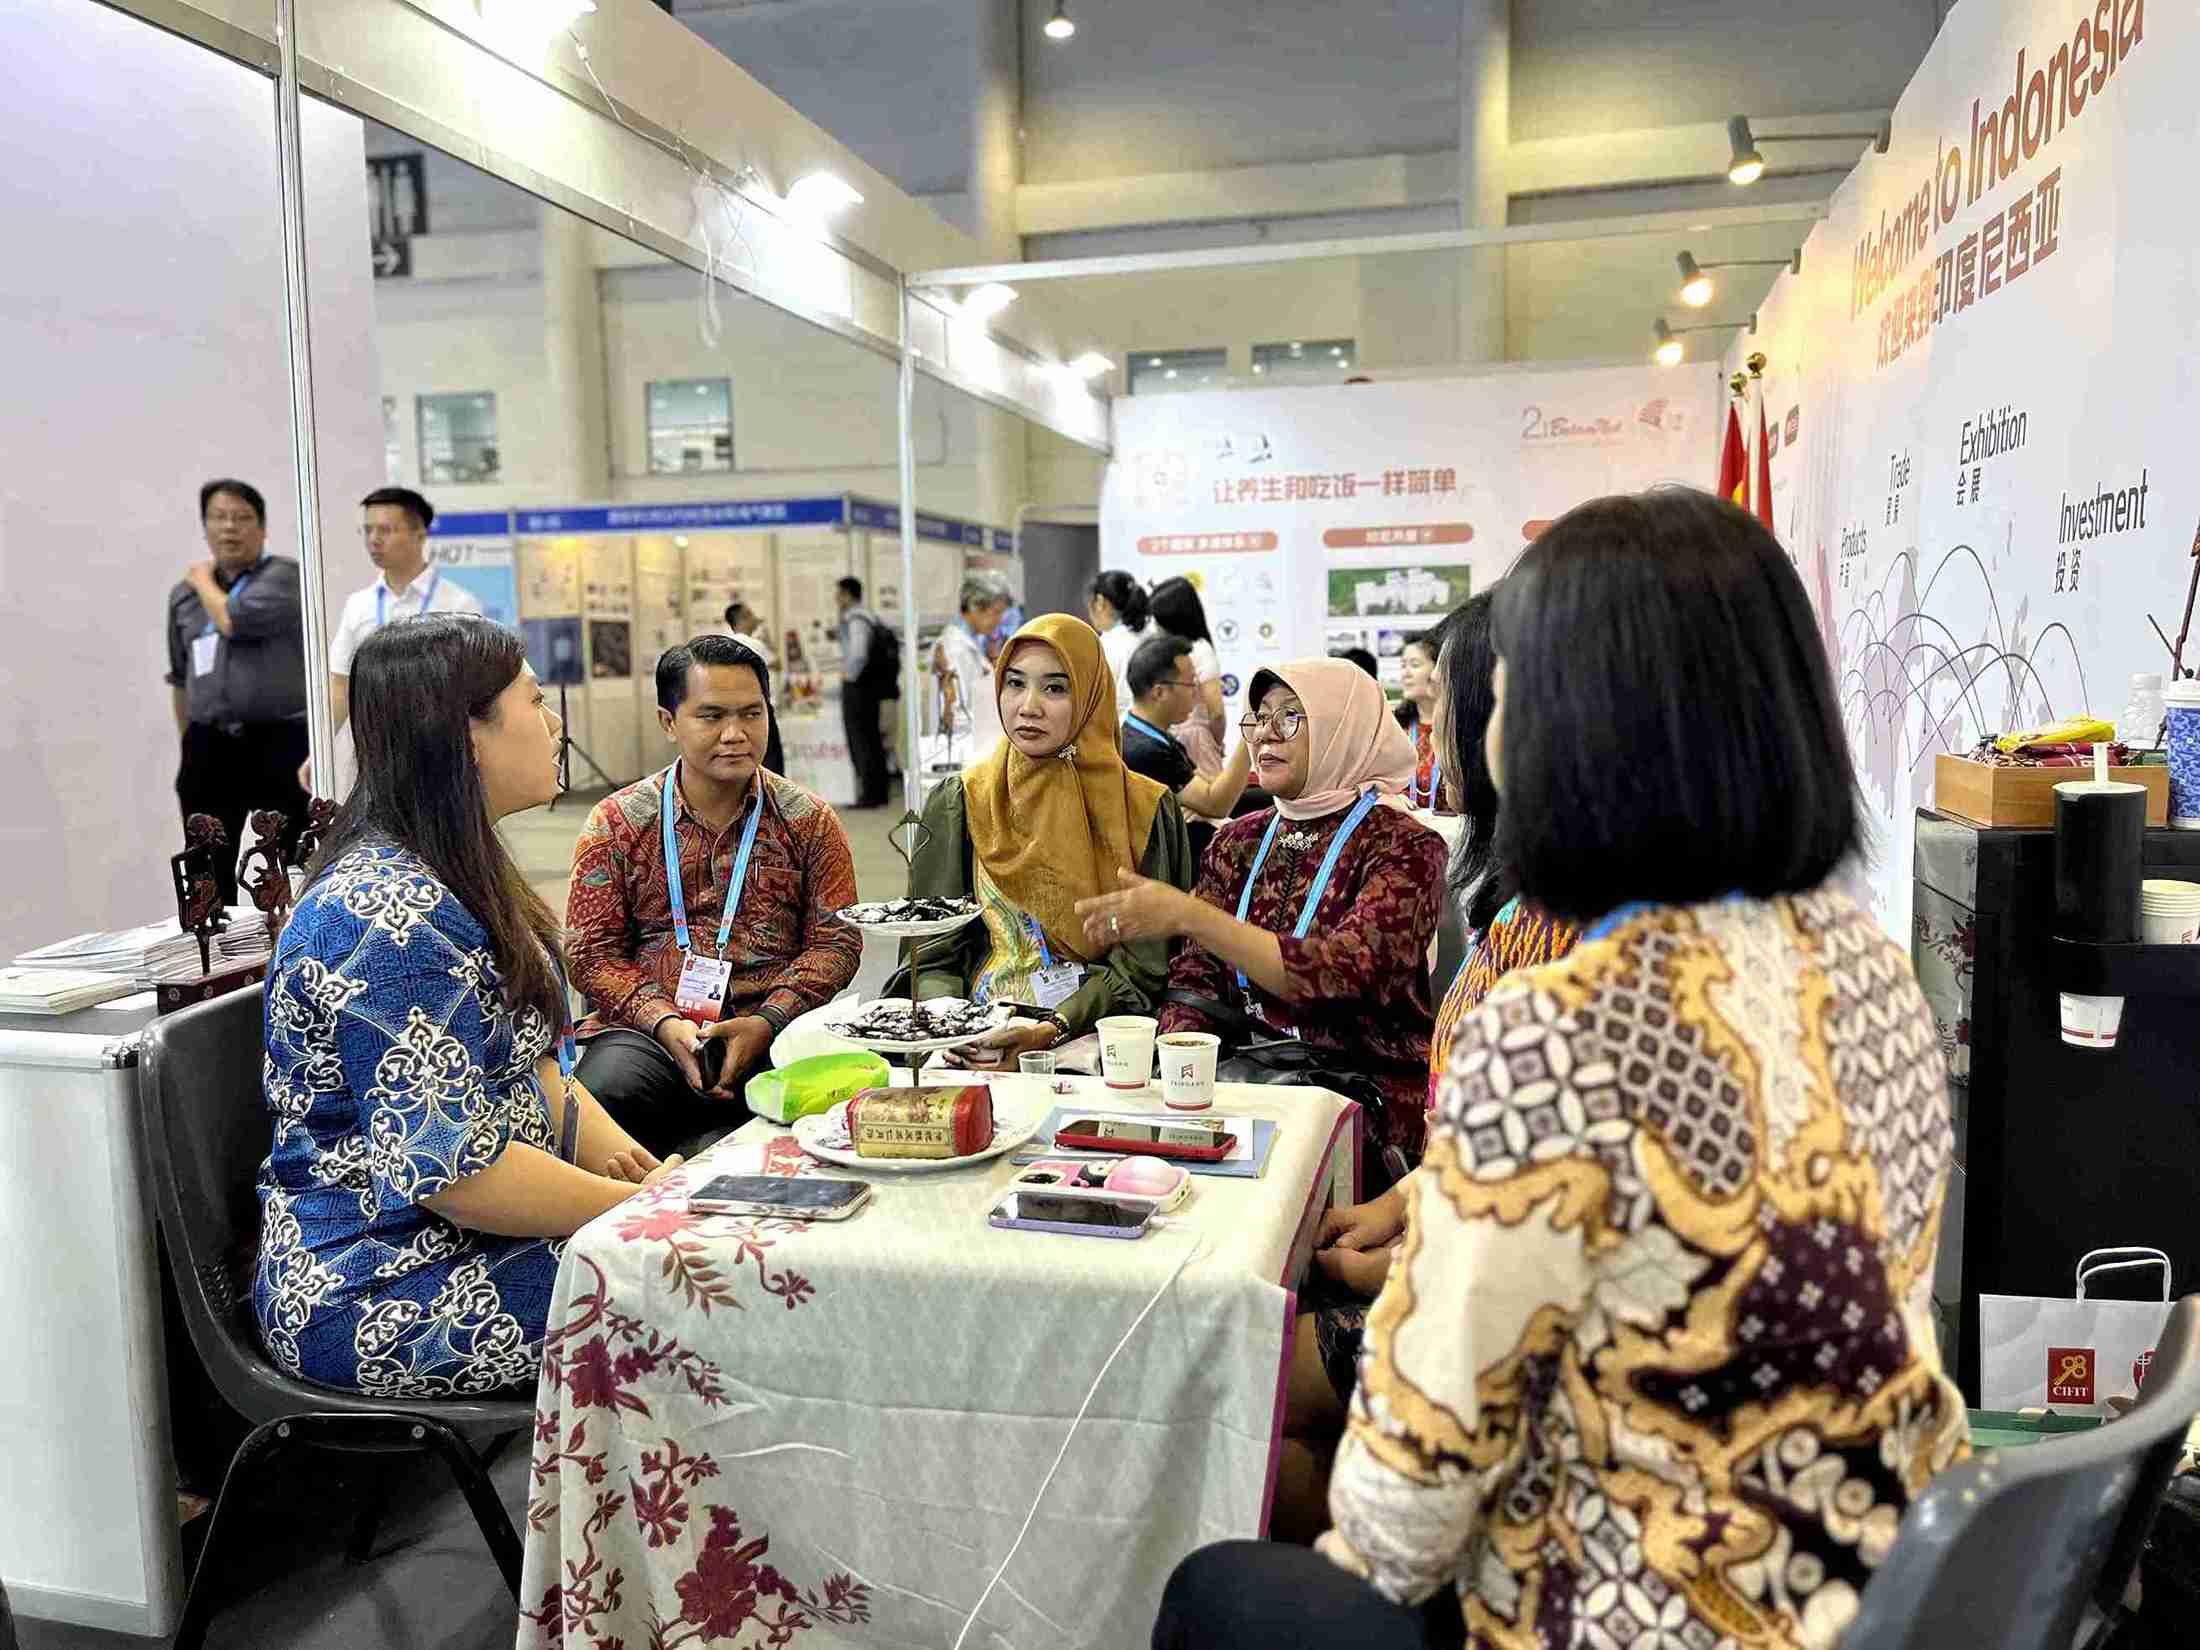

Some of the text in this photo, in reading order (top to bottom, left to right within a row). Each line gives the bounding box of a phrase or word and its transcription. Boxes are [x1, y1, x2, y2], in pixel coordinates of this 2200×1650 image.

[1852, 0, 2144, 318] Welcome to Indonesia
[1959, 405, 2028, 466] Exhibition
[1213, 467, 1457, 504] 让养生和吃饭一样简单
[1888, 448, 1911, 492] Trade
[1955, 466, 1982, 506] 会展
[2059, 468, 2149, 543] Investment
[2055, 547, 2081, 593] 投资
